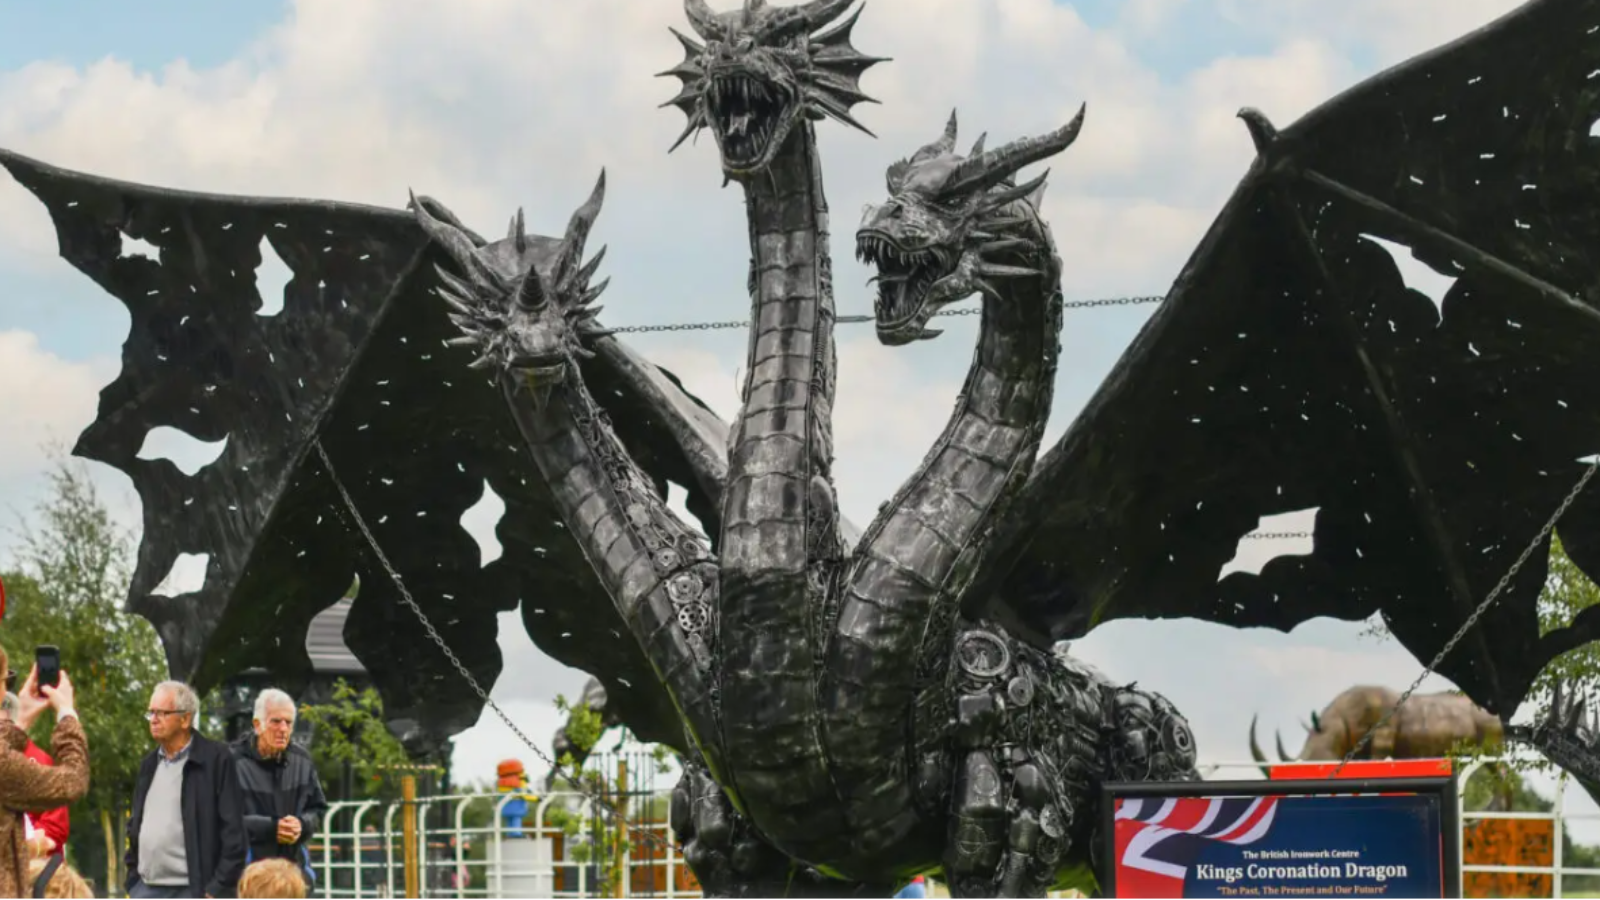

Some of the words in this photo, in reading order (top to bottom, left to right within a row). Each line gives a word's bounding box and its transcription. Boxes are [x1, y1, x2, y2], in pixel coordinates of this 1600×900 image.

[1242, 850, 1259, 859] The
[1260, 850, 1289, 859] British
[1291, 850, 1330, 859] Ironwork
[1331, 850, 1360, 858] Centre
[1196, 864, 1244, 883] Kings
[1247, 863, 1341, 879] Coronation
[1345, 862, 1407, 881] Dragon
[1262, 886, 1279, 895] The
[1280, 886, 1316, 895] Present
[1316, 885, 1333, 894] and
[1335, 885, 1352, 894] Our
